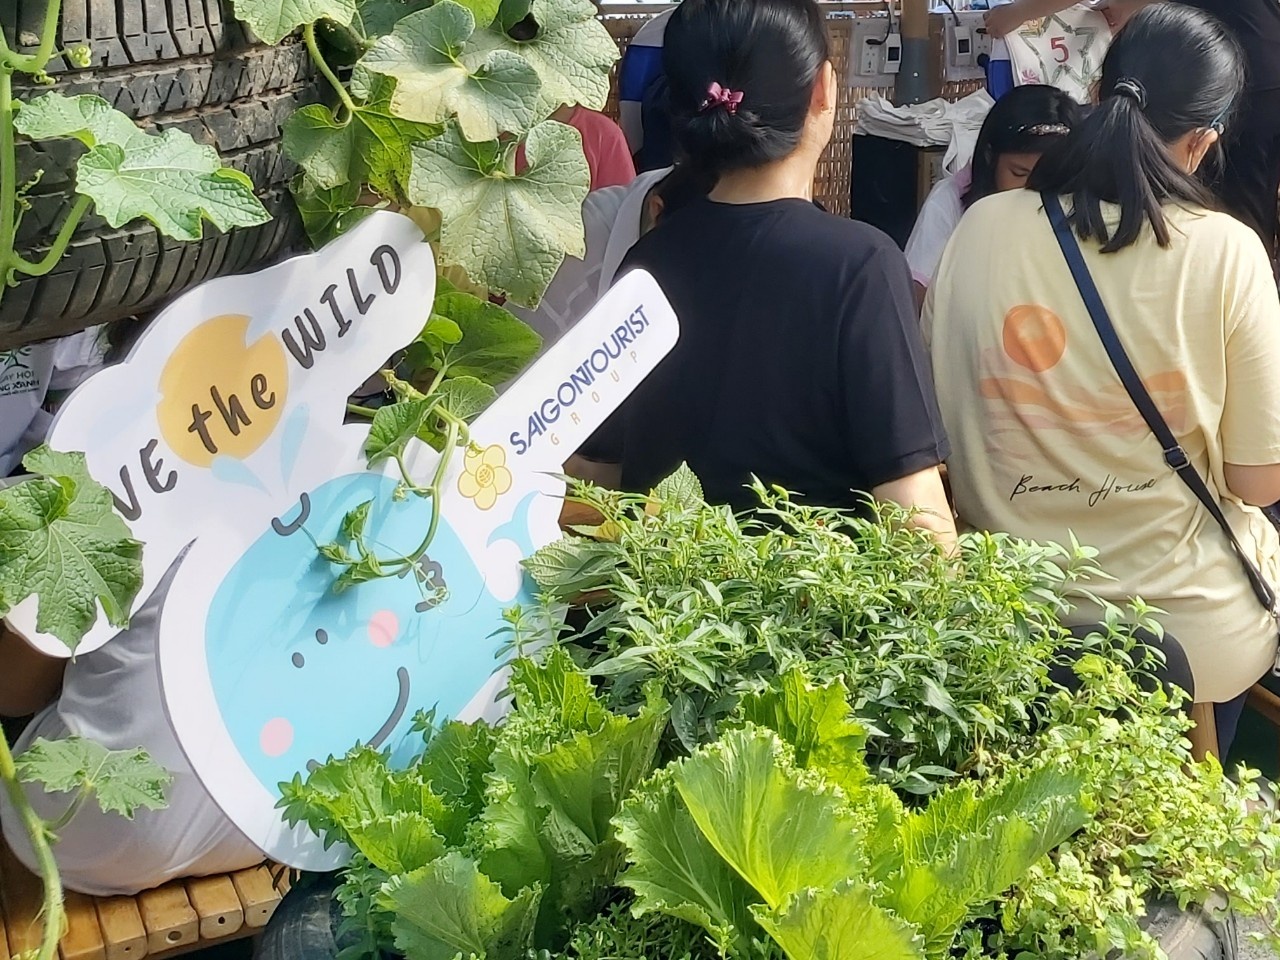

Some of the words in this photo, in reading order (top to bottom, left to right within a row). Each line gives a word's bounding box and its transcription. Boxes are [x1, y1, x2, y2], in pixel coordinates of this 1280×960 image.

[1050, 37, 1069, 63] 5
[281, 244, 401, 370] WILD
[188, 373, 276, 455] the
[509, 304, 650, 455] SAIGONTOURIST
[550, 350, 638, 446] GROUP
[1010, 474, 1080, 501] Beach
